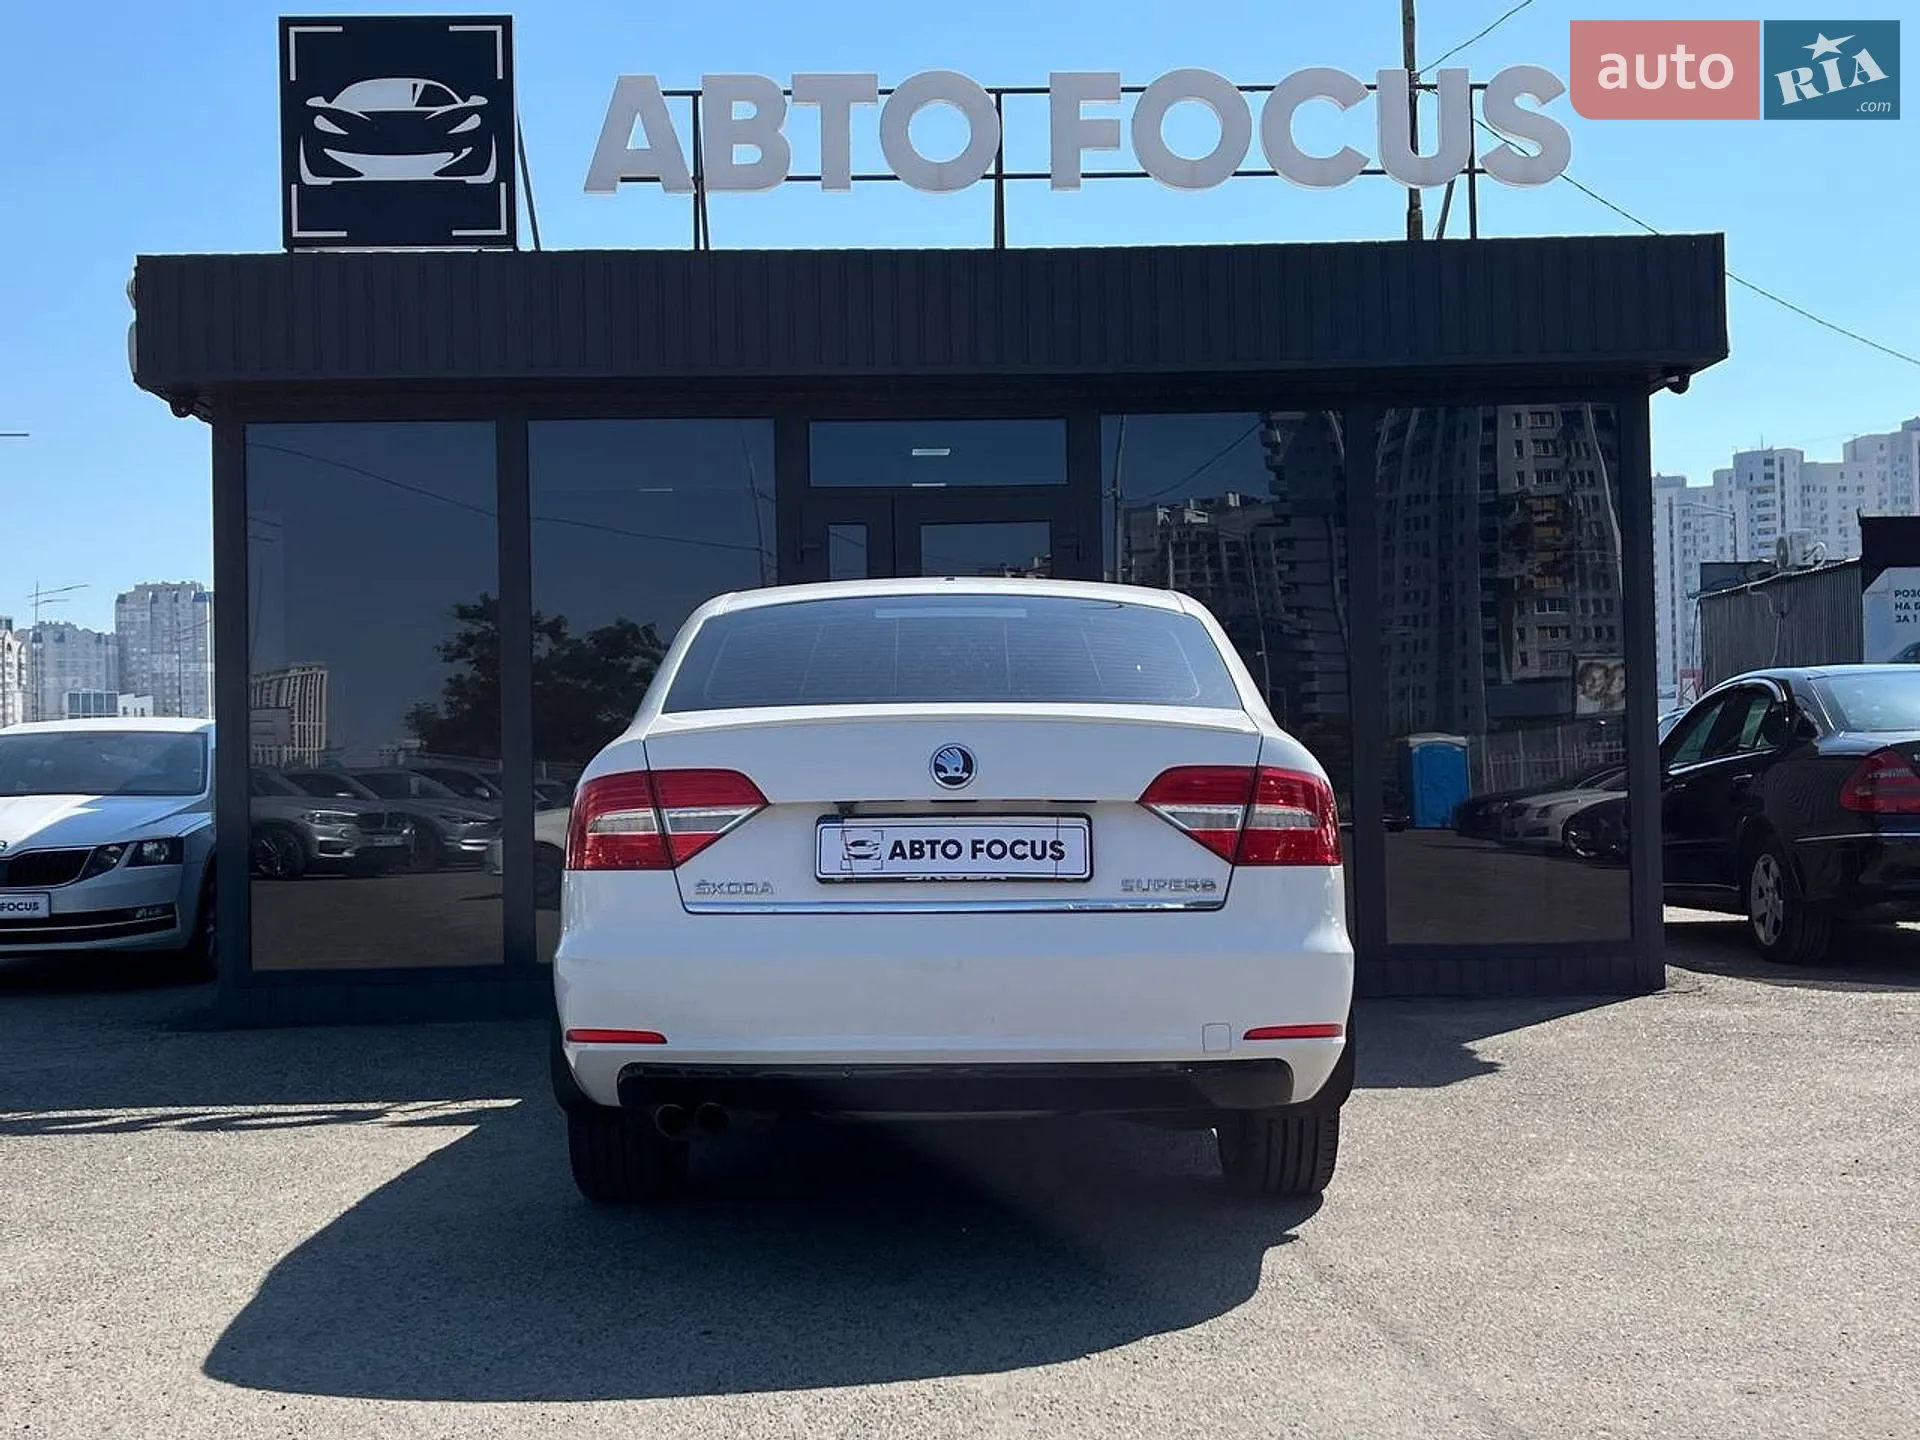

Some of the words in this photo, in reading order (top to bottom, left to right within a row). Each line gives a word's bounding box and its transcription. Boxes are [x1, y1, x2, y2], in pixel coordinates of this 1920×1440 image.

[583, 69, 1001, 195] АВТО
[1049, 64, 1572, 191] FOCUS
[1895, 602, 1910, 610] НА
[1895, 614, 1909, 623] ЗА
[888, 839, 962, 861] АВТО
[970, 839, 1066, 861] FOCUS
[1121, 879, 1217, 892] SUPERB
